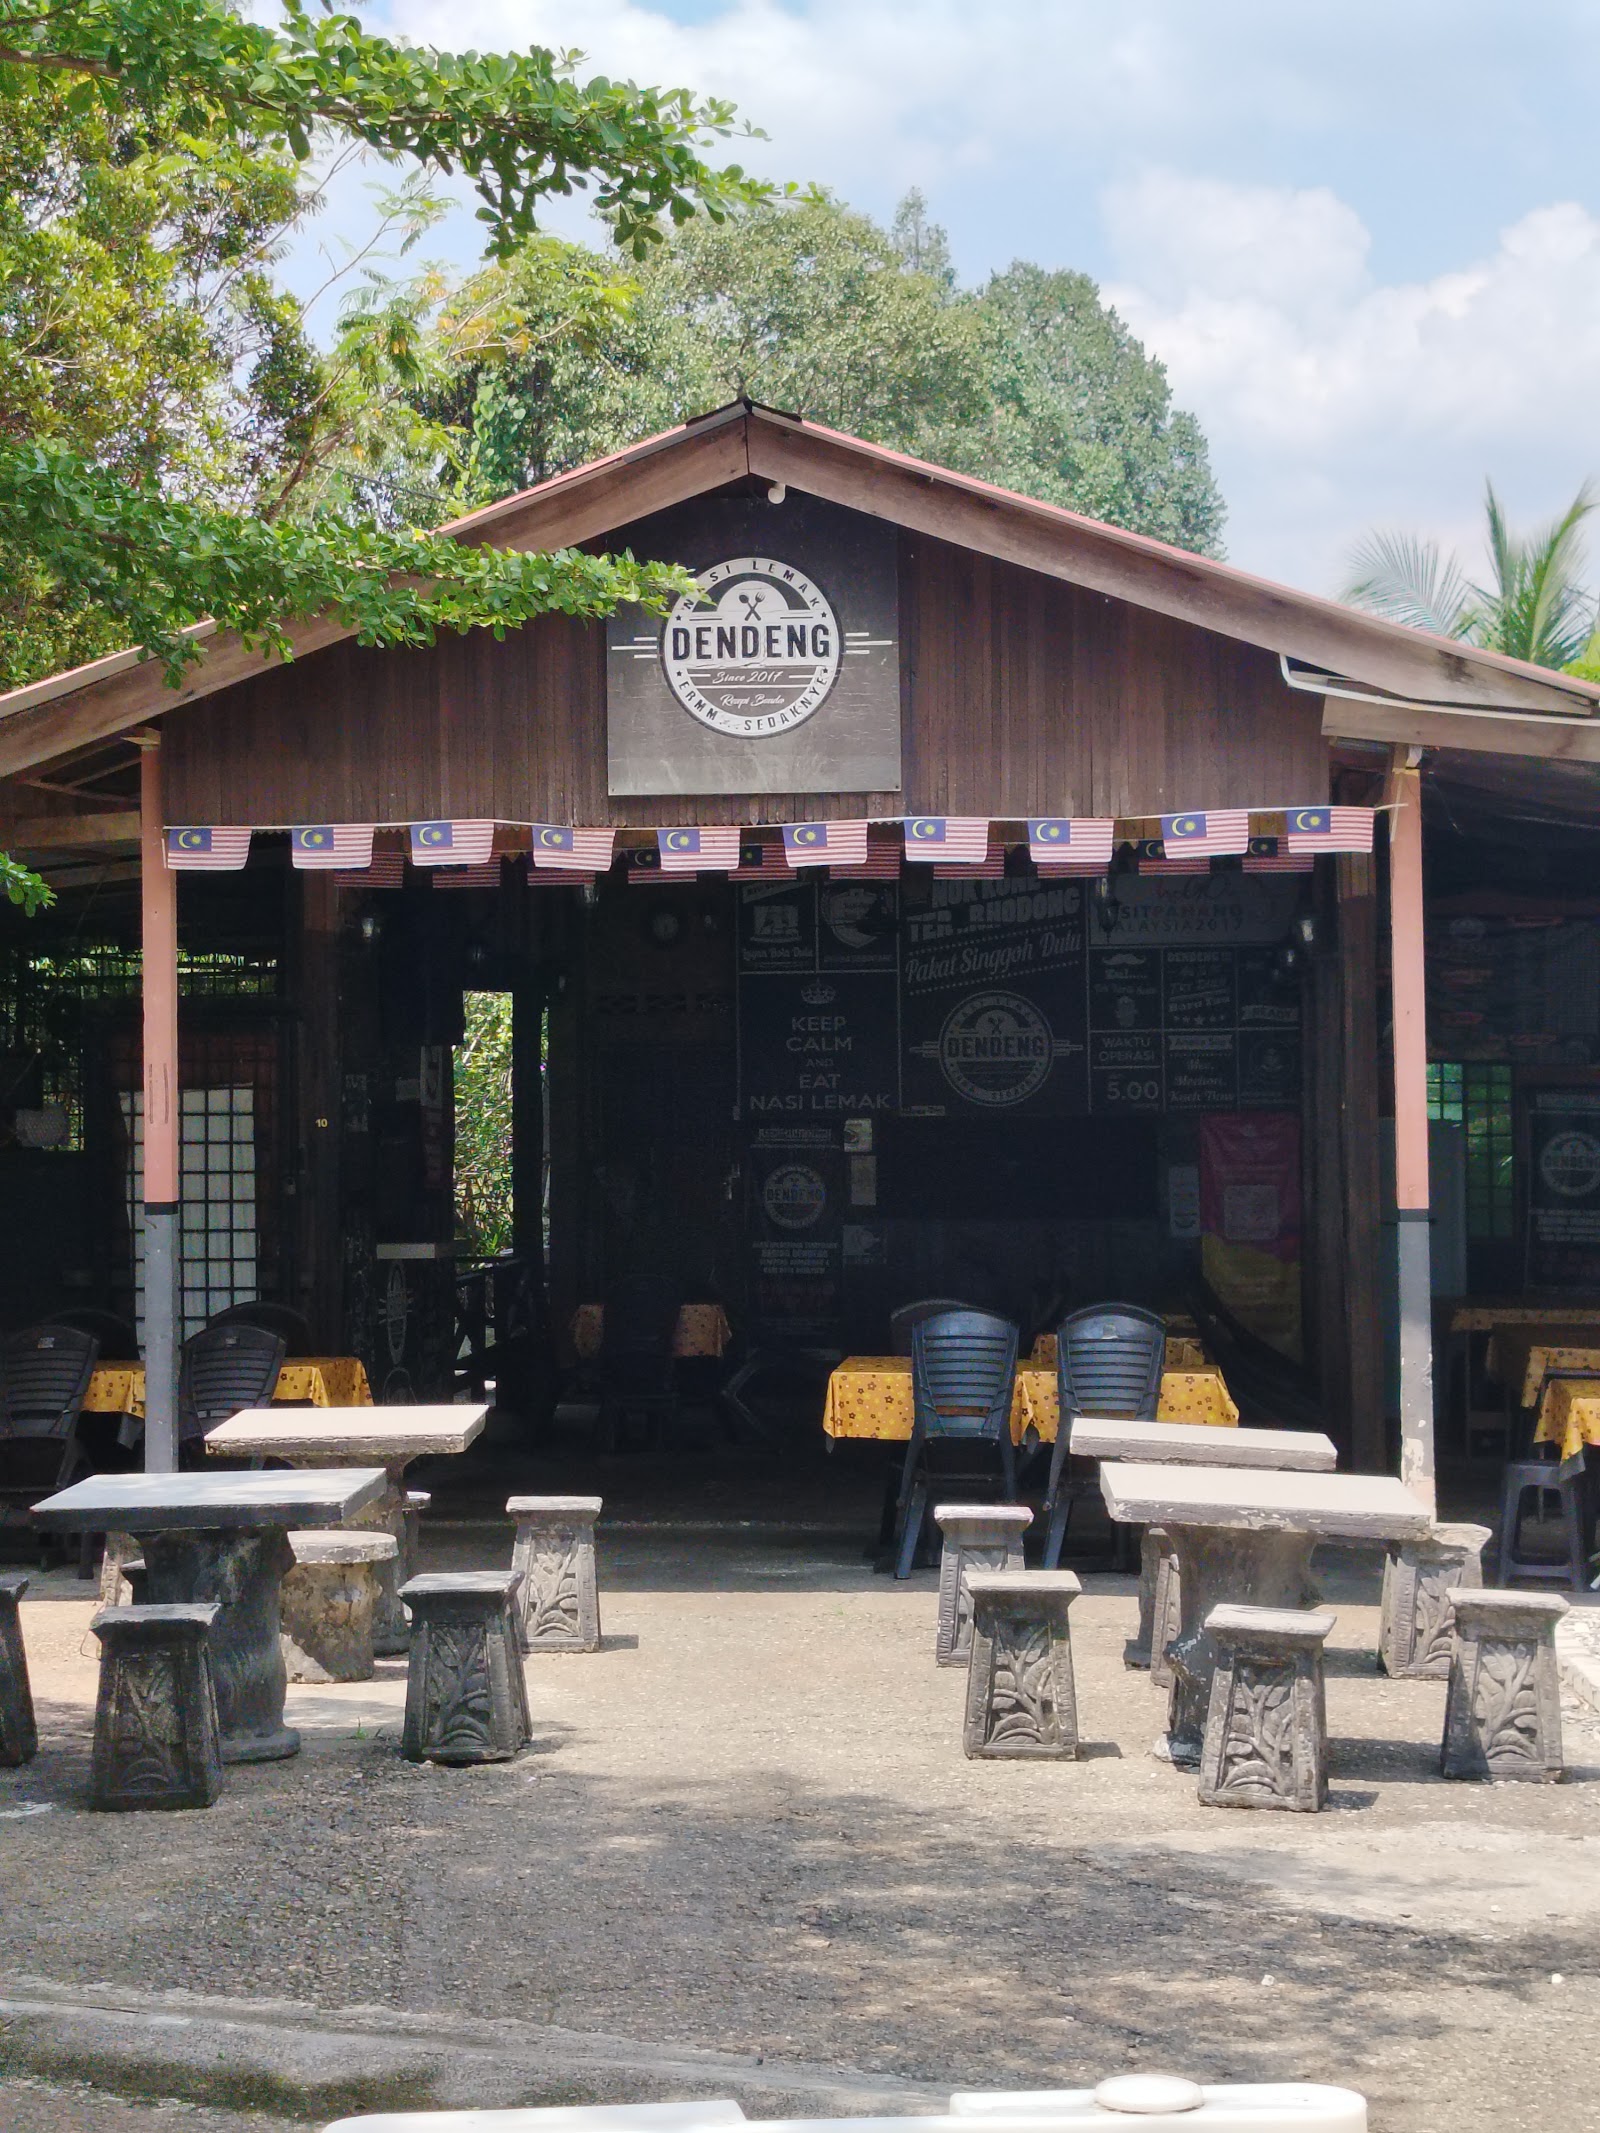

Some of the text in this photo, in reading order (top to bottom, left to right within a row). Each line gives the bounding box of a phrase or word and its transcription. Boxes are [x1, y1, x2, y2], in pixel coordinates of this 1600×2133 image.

[682, 559, 820, 611] NSI LEMAK
[672, 623, 831, 661] DENDENG
[712, 670, 783, 684] Since 2017
[1112, 919, 1193, 934] ALAYSIA
[791, 1016, 848, 1031] KEEP
[786, 1036, 853, 1051] CALM
[947, 1036, 1044, 1058] DENDENG
[1102, 1036, 1151, 1048] WAKTU
[805, 1058, 835, 1067] AND
[1098, 1050, 1155, 1062] OPERASI
[800, 1073, 841, 1089] EAT
[1107, 1080, 1160, 1100] 5.00
[751, 1094, 891, 1110] NASI LEMAK
[315, 1118, 328, 1128] 10
